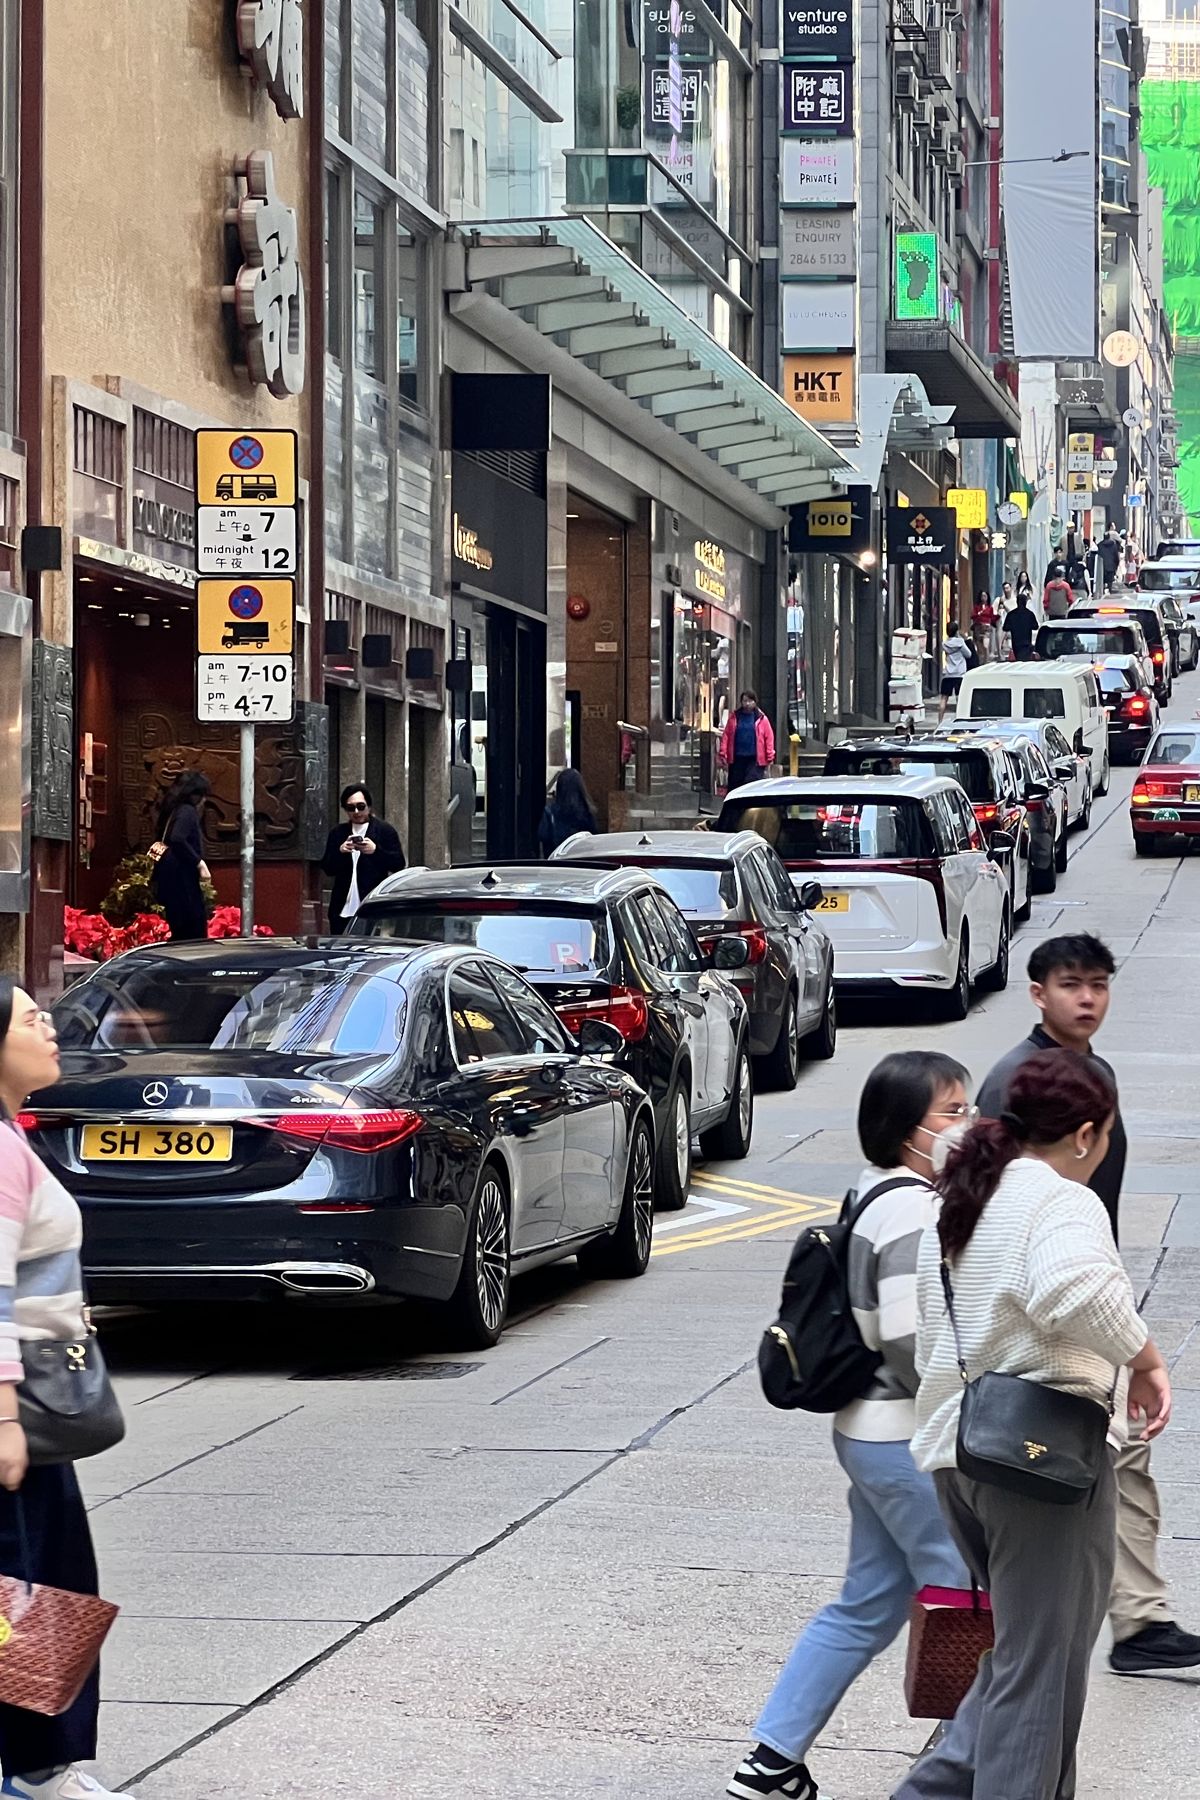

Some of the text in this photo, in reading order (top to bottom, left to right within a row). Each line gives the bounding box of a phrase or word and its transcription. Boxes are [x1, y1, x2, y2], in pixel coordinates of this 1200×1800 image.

[788, 10, 848, 23] venture
[798, 24, 838, 35] studios
[800, 172, 832, 185] PRIVATE
[795, 219, 841, 230] LEASING
[795, 232, 842, 243] ENQUIRY
[790, 253, 847, 265] 2846 5133
[794, 371, 842, 391] HKT
[794, 391, 841, 402] 香港電訊
[215, 521, 243, 533] 上午
[220, 510, 276, 533] am 7
[203, 545, 290, 569] midnight 12
[215, 557, 243, 569] 午夜
[208, 662, 287, 682] am 7-10
[203, 674, 230, 685] 上午
[203, 703, 230, 714] 下午
[208, 692, 274, 713] pm 4-7
[554, 988, 593, 998] X3
[99, 1131, 215, 1155] SH 380
